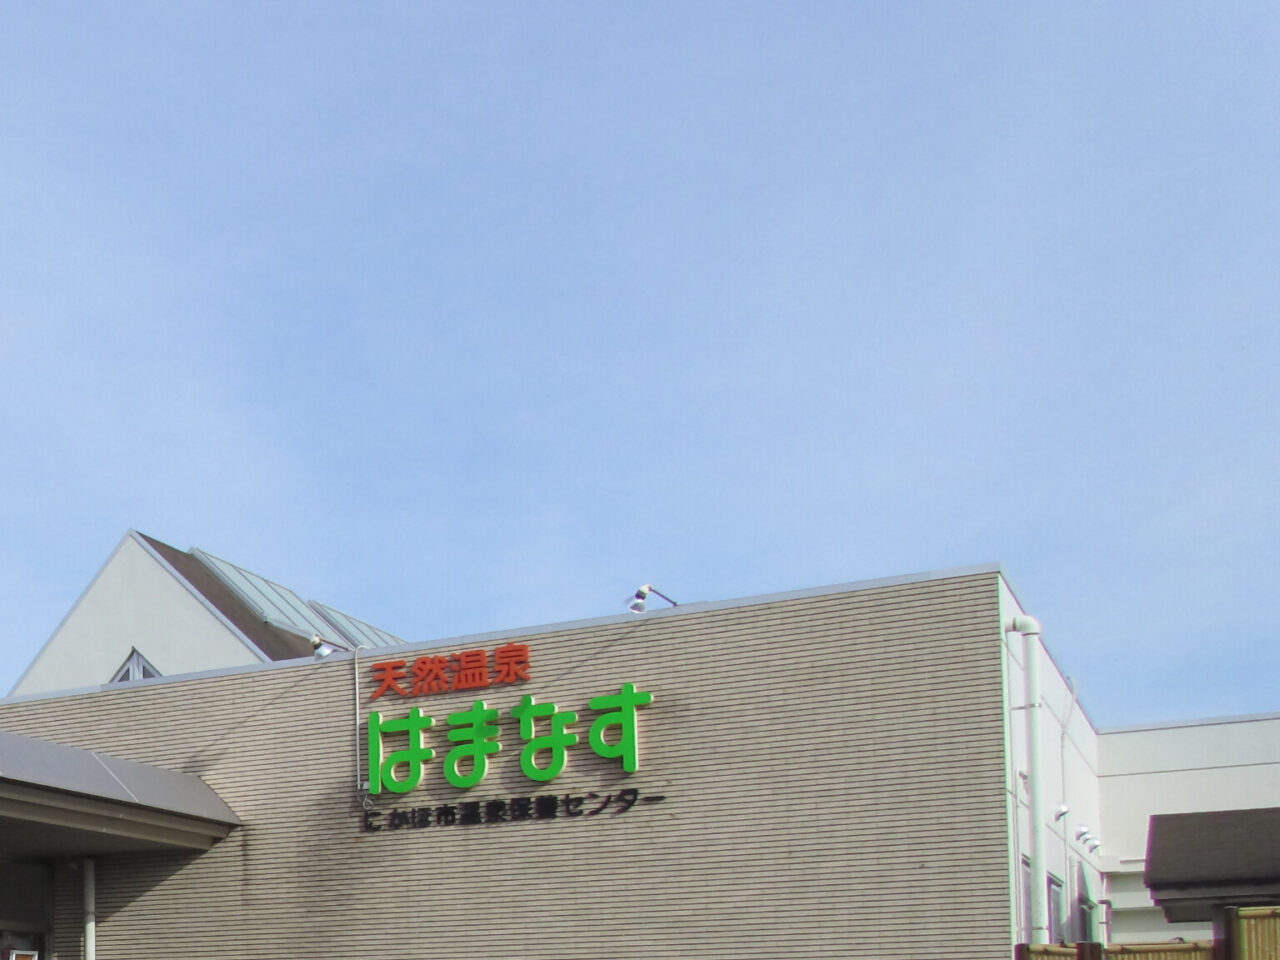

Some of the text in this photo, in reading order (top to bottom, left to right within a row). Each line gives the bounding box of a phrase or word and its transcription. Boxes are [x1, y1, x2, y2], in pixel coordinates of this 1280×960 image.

[370, 642, 533, 700] 天然温泉
[368, 682, 655, 795] はまなす
